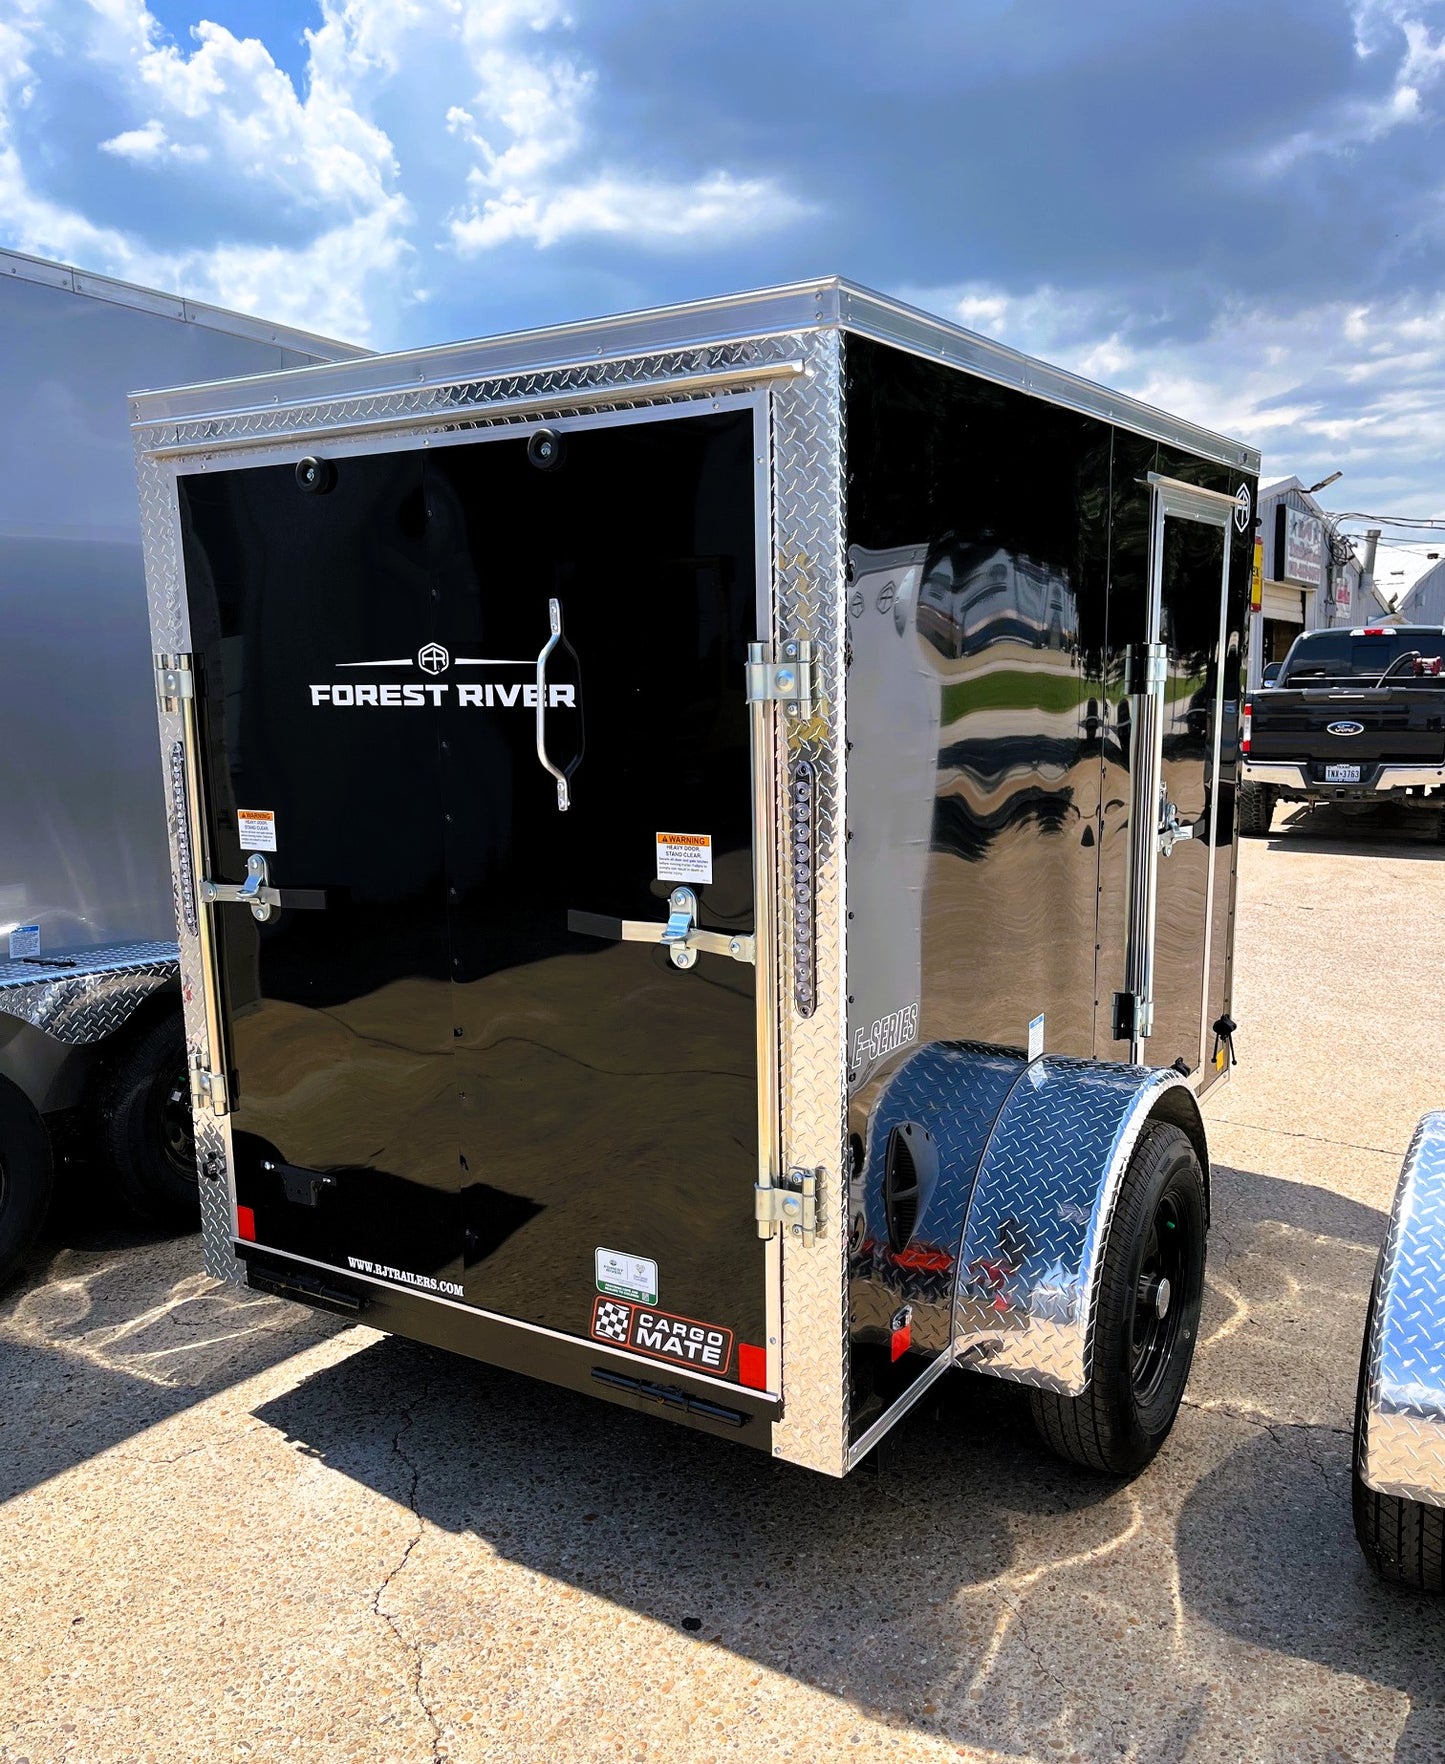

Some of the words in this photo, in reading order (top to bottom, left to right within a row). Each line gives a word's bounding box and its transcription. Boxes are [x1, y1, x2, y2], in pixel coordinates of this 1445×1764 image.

[309, 684, 449, 706] FOREST
[456, 684, 577, 708] RIVER
[1335, 724, 1356, 733] Ford
[669, 836, 705, 845] WARNING
[851, 1002, 919, 1069] E-SERIES
[347, 1256, 465, 1297] WWW.RJTRAILERS.COM
[636, 1328, 722, 1366] MATE
[638, 1313, 724, 1347] CARGO
